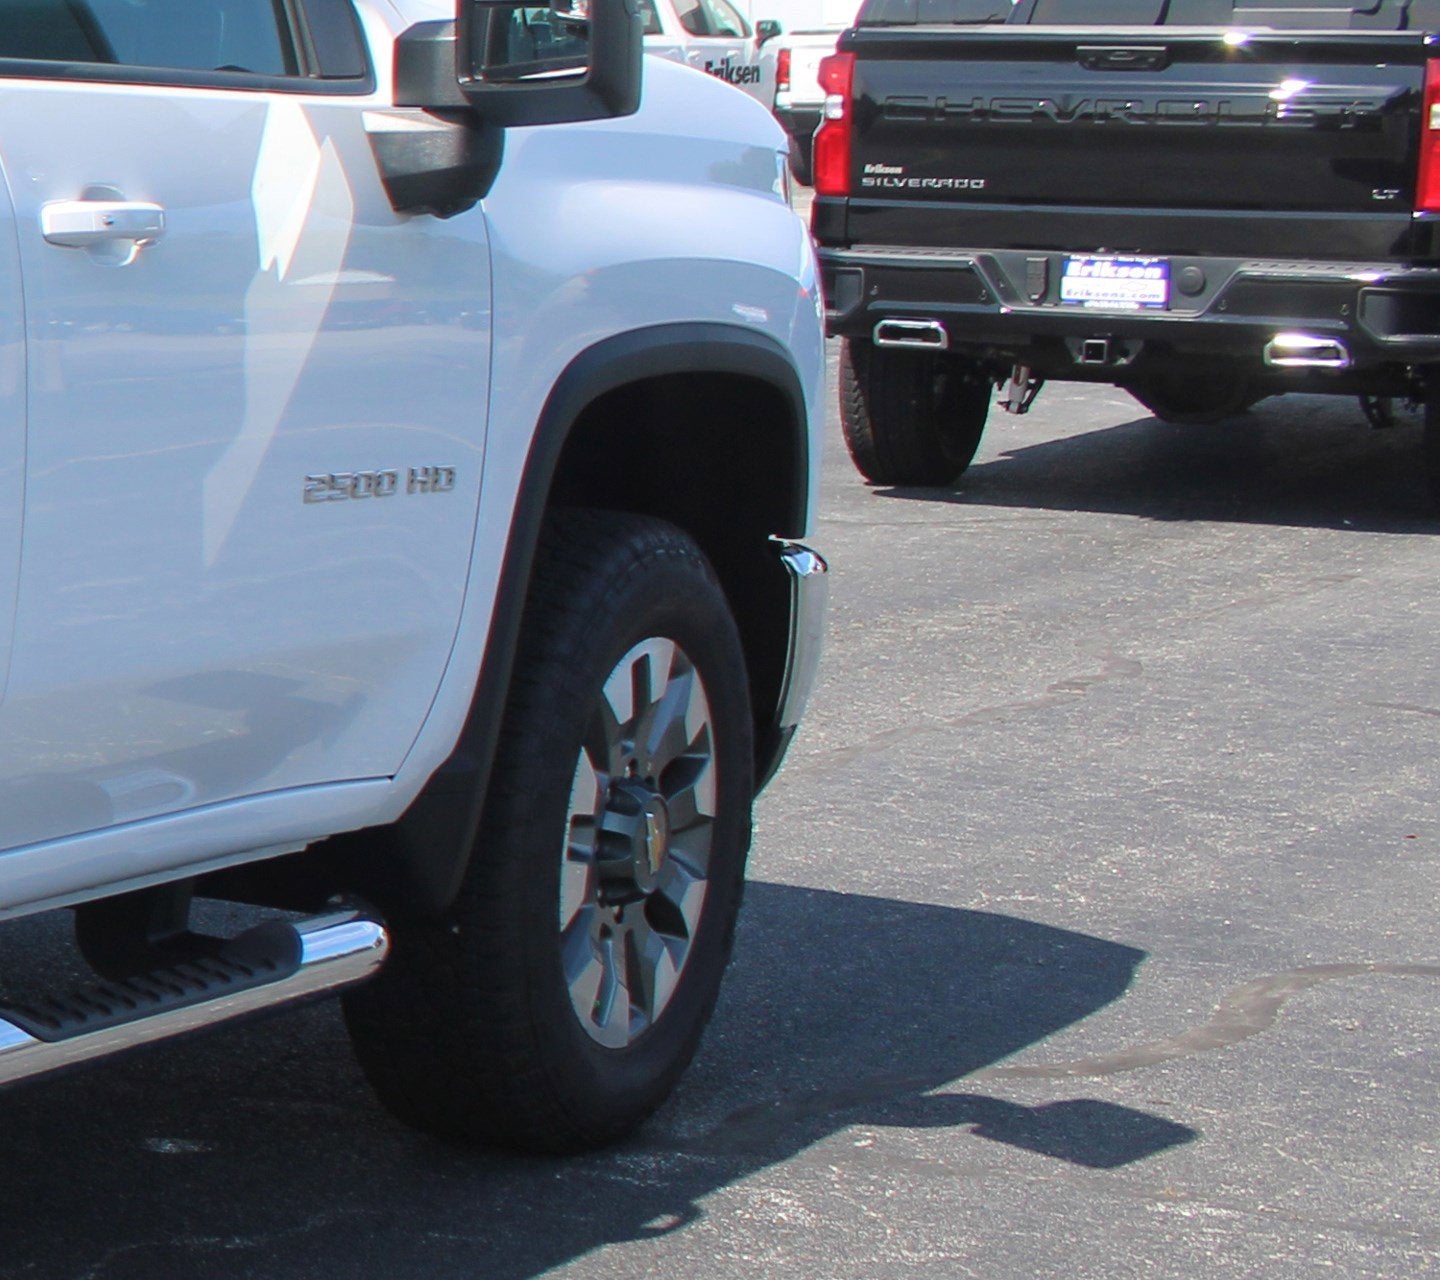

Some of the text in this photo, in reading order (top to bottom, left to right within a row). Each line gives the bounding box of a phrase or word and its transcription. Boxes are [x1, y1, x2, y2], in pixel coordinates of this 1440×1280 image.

[883, 95, 1375, 129] CHEVROLET
[861, 177, 986, 190] SILVERADO
[303, 464, 456, 504] 2500 HD
